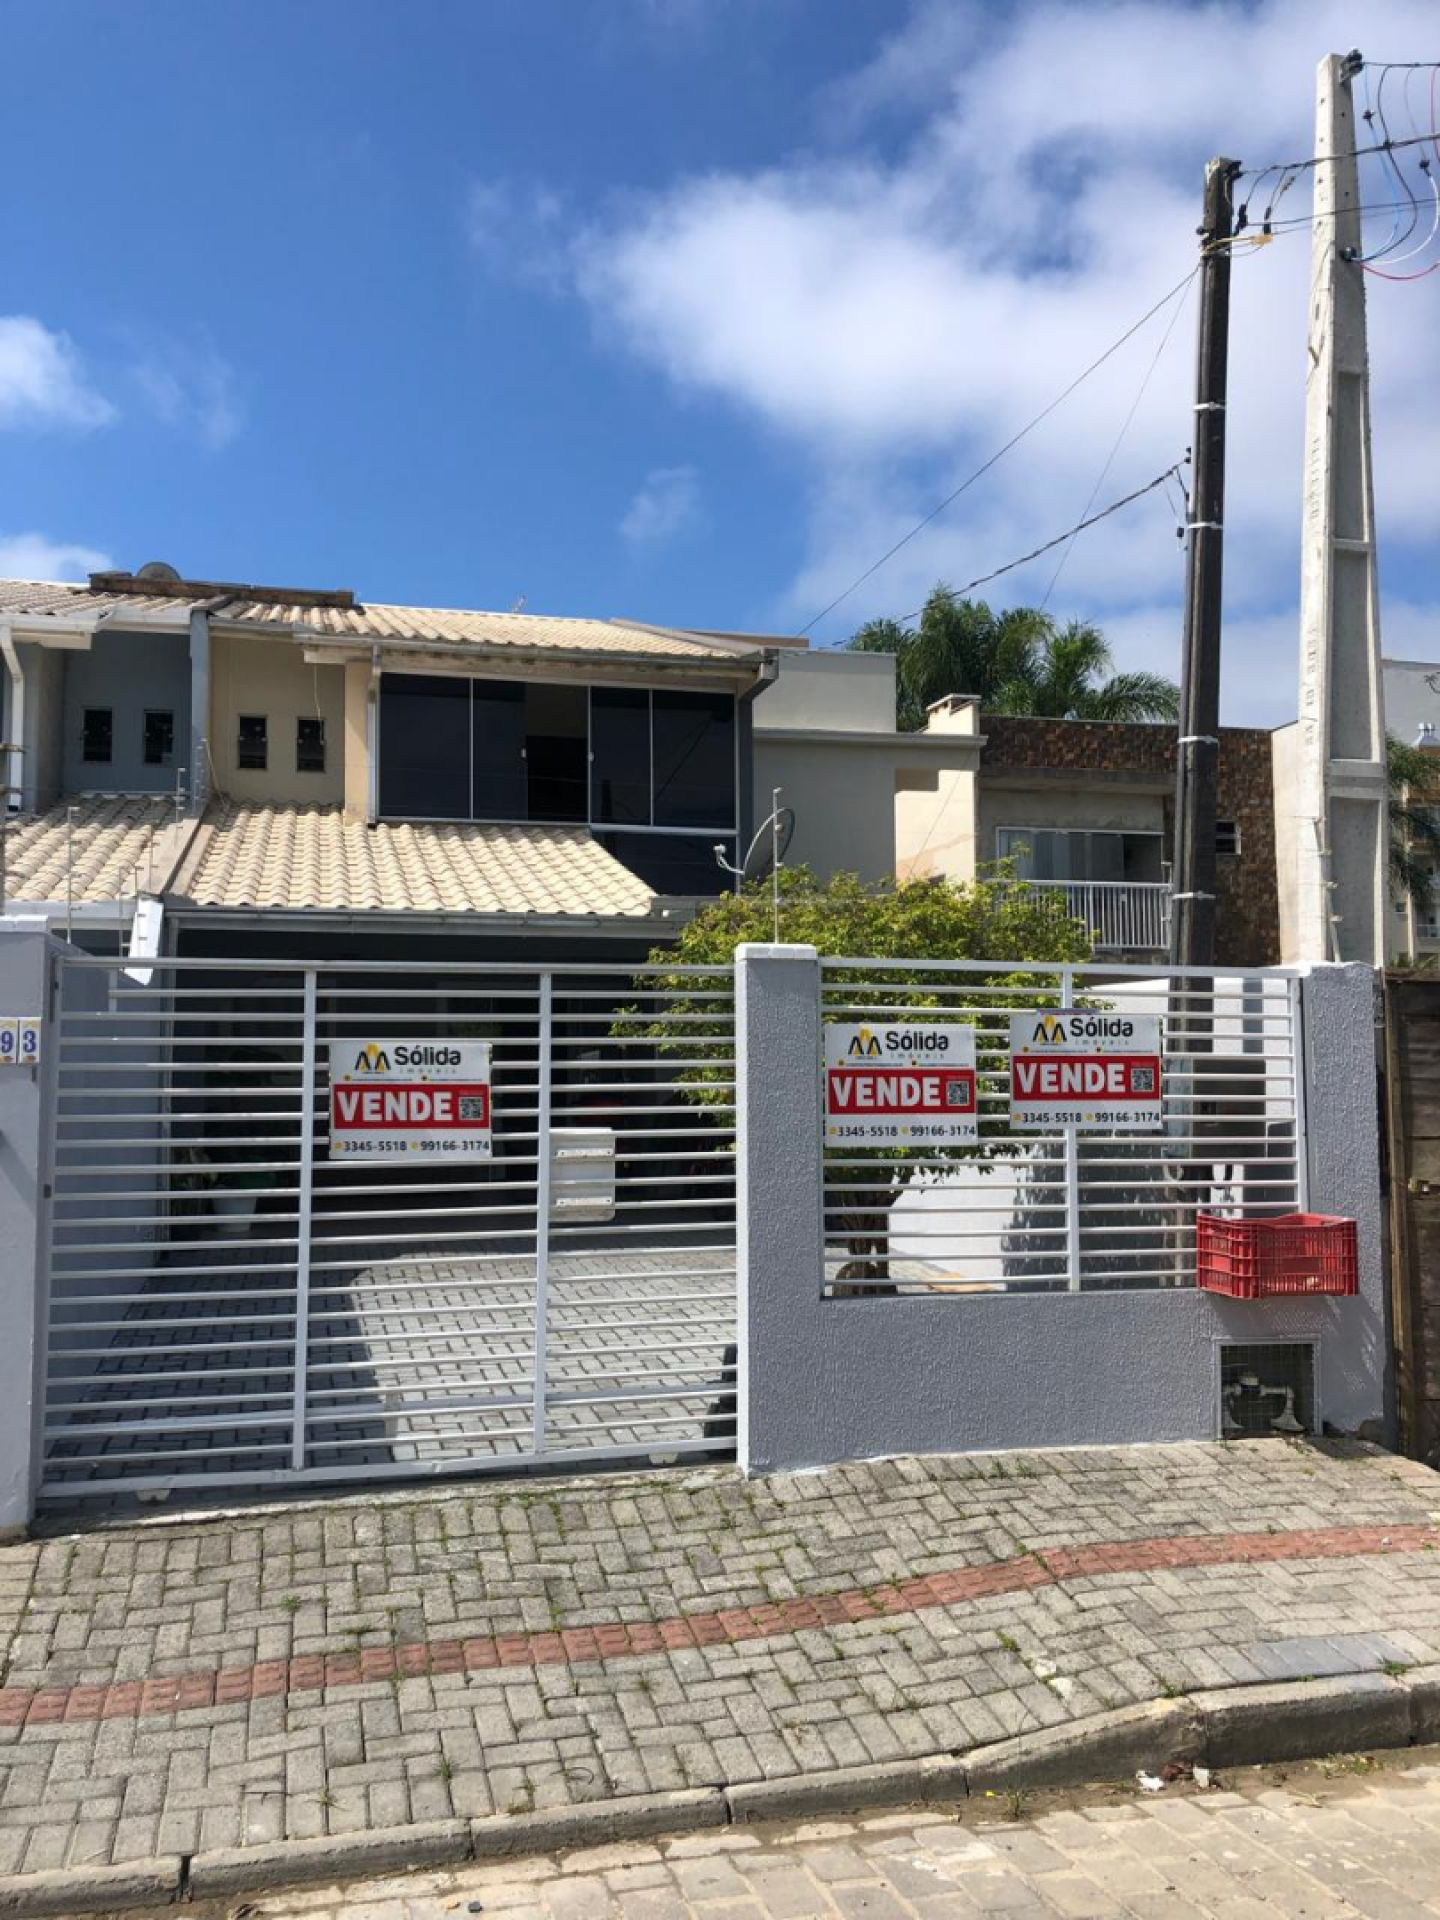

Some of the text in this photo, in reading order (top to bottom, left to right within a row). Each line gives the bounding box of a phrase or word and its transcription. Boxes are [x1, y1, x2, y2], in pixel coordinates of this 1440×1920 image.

[1070, 1017, 1133, 1037] Sólida
[885, 1030, 948, 1050] Sólida
[394, 1045, 461, 1066] Sólida
[1016, 1063, 1126, 1093] VENDE
[831, 1076, 941, 1107] VENDE
[336, 1091, 454, 1122] VENDE
[1022, 1112, 1160, 1123] 3345-5518 99166-3174
[838, 1126, 976, 1137] 3345-5518 99166-3174
[344, 1140, 489, 1151] 3345-5518 99166-3174
